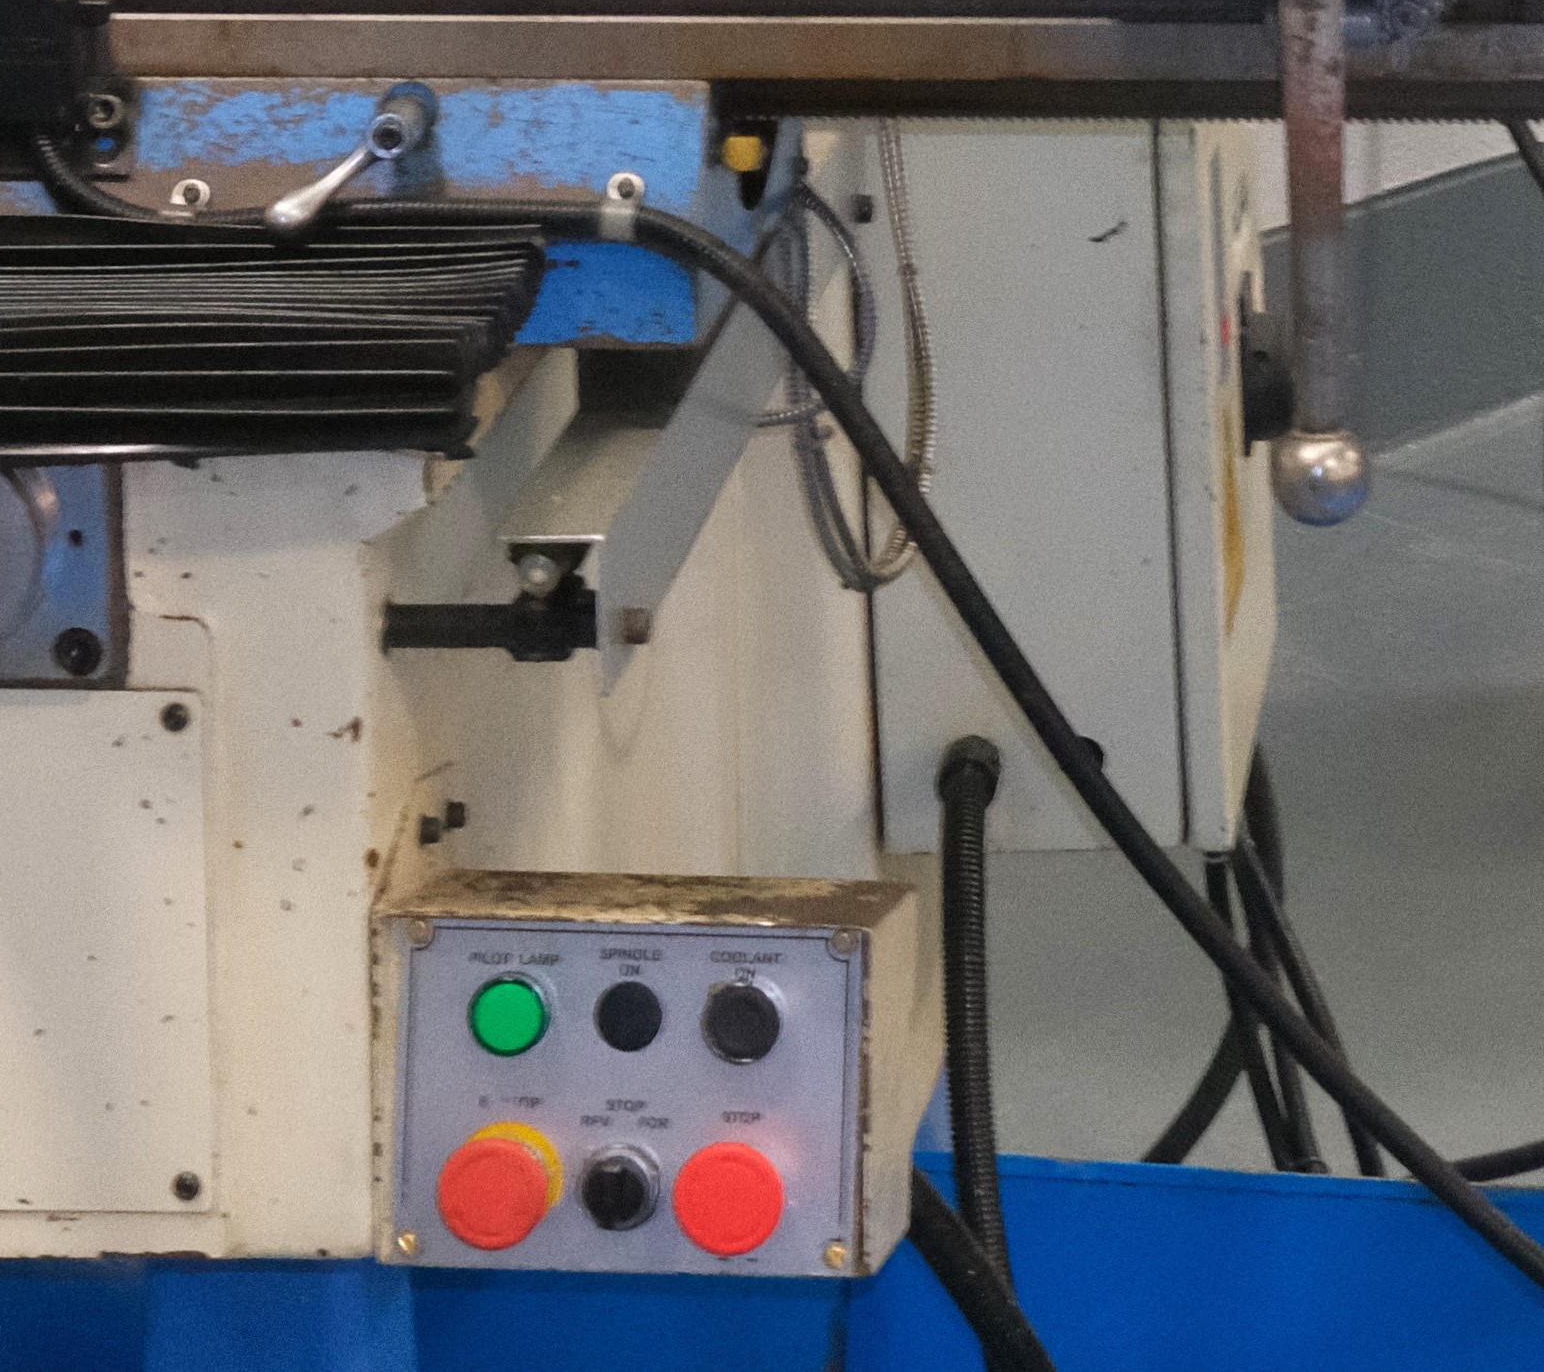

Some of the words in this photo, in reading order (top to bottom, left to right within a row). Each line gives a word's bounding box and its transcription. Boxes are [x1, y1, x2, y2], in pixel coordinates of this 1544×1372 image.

[518, 953, 561, 966] LAMP
[709, 950, 784, 964] COOLANT
[605, 1099, 648, 1112] STOP
[721, 1111, 763, 1124] STOP
